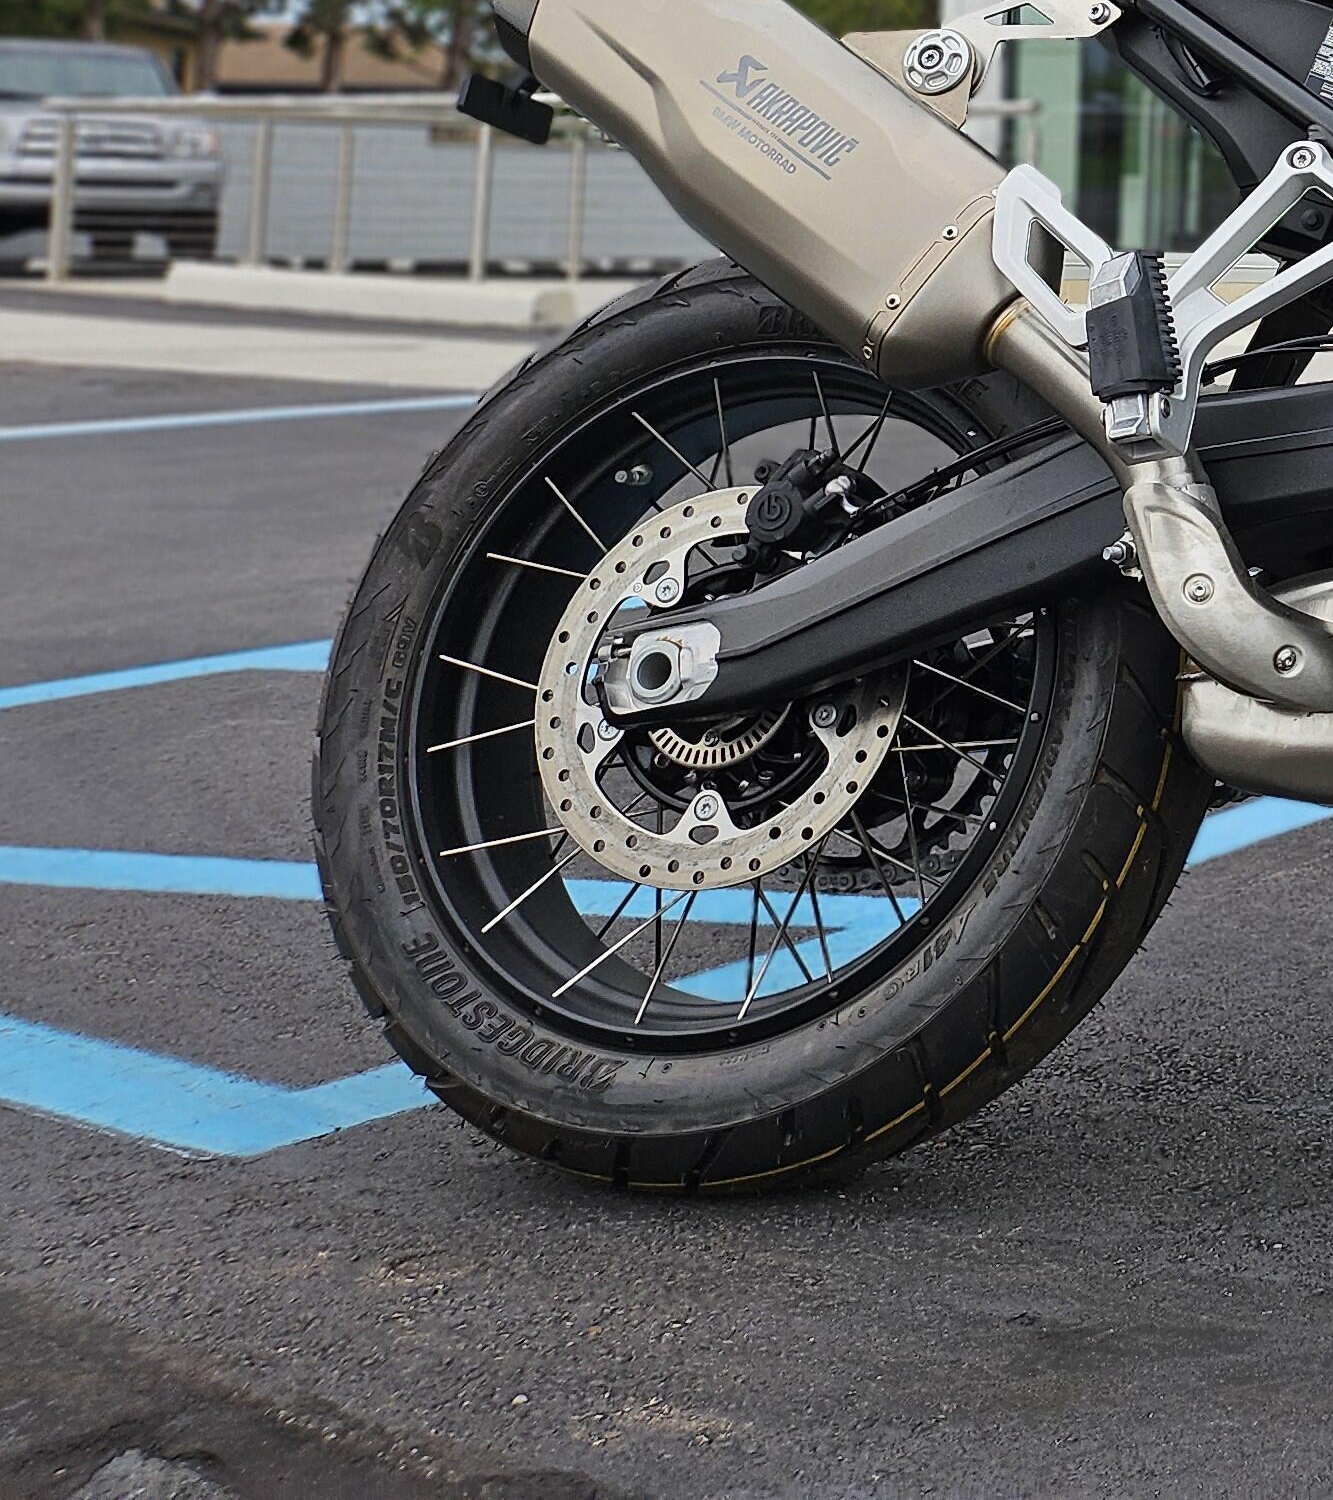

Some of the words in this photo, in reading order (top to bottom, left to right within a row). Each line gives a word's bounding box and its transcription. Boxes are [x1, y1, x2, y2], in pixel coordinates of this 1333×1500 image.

[711, 106, 741, 131] BMW
[738, 125, 797, 175] MOTORRAD
[392, 931, 618, 1093] BRIDGESTONE
